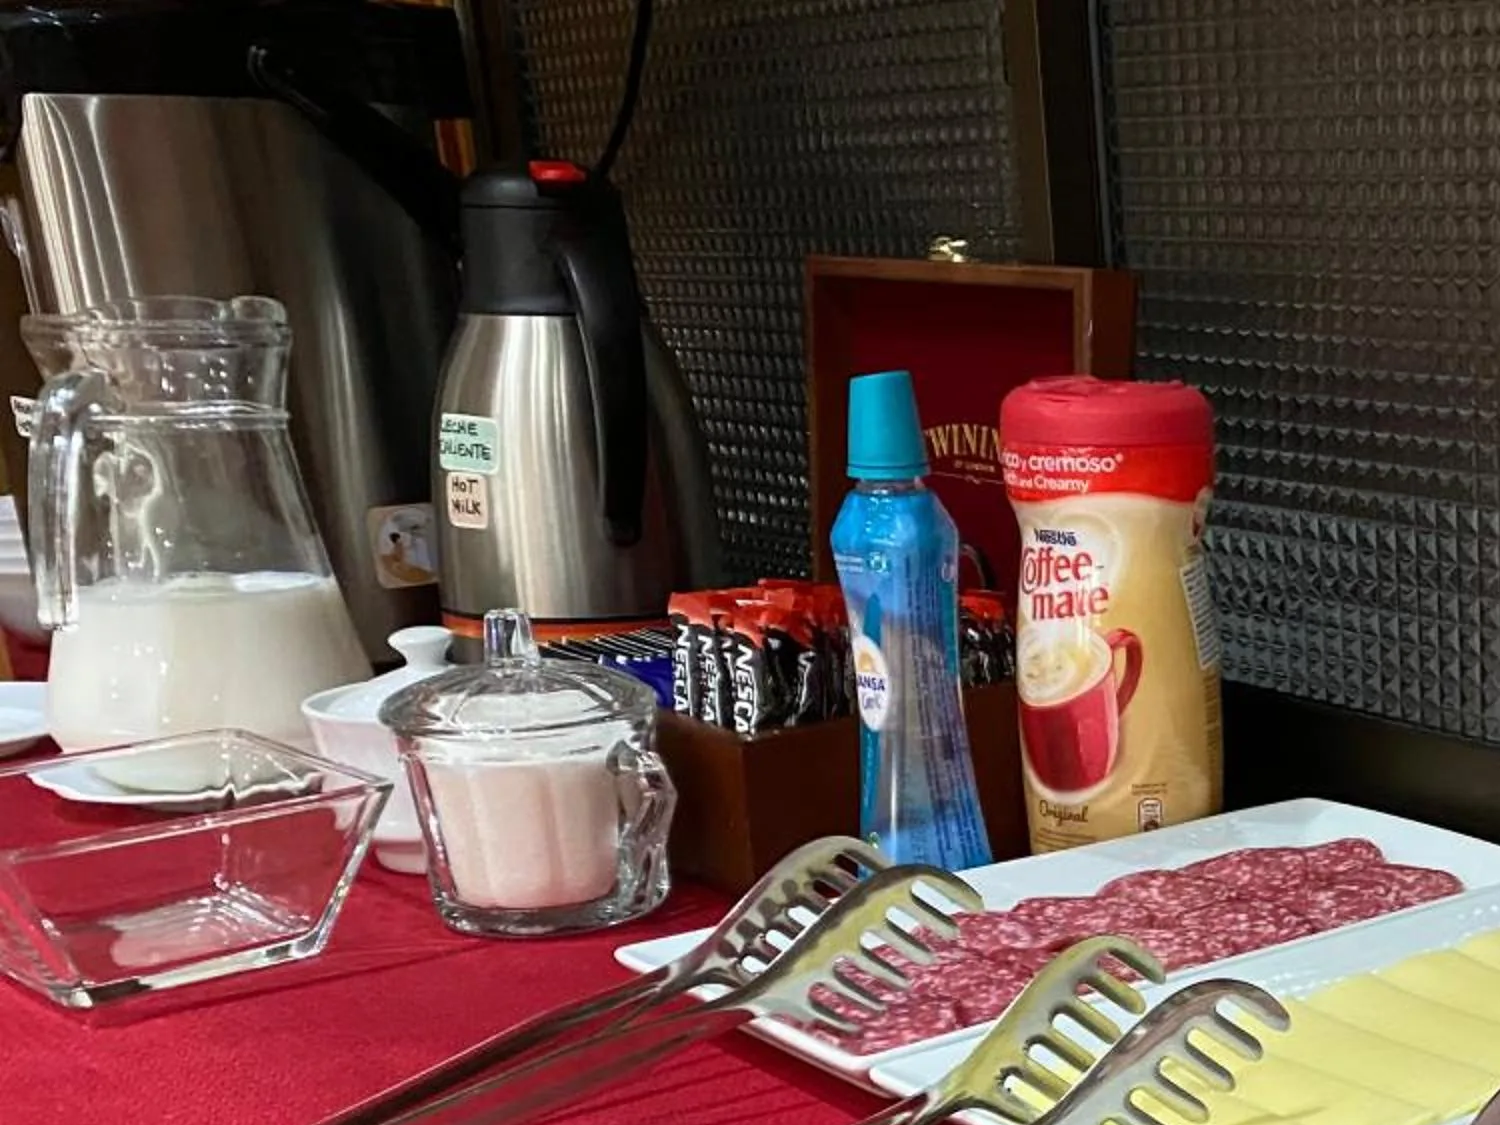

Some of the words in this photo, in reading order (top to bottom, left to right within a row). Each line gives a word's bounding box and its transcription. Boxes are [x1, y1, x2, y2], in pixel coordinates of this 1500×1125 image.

[441, 419, 479, 437] LECHE
[923, 423, 1000, 462] WININ
[1033, 473, 1089, 493] Creamy
[1032, 586, 1110, 621] mate
[1039, 799, 1089, 827] Original
